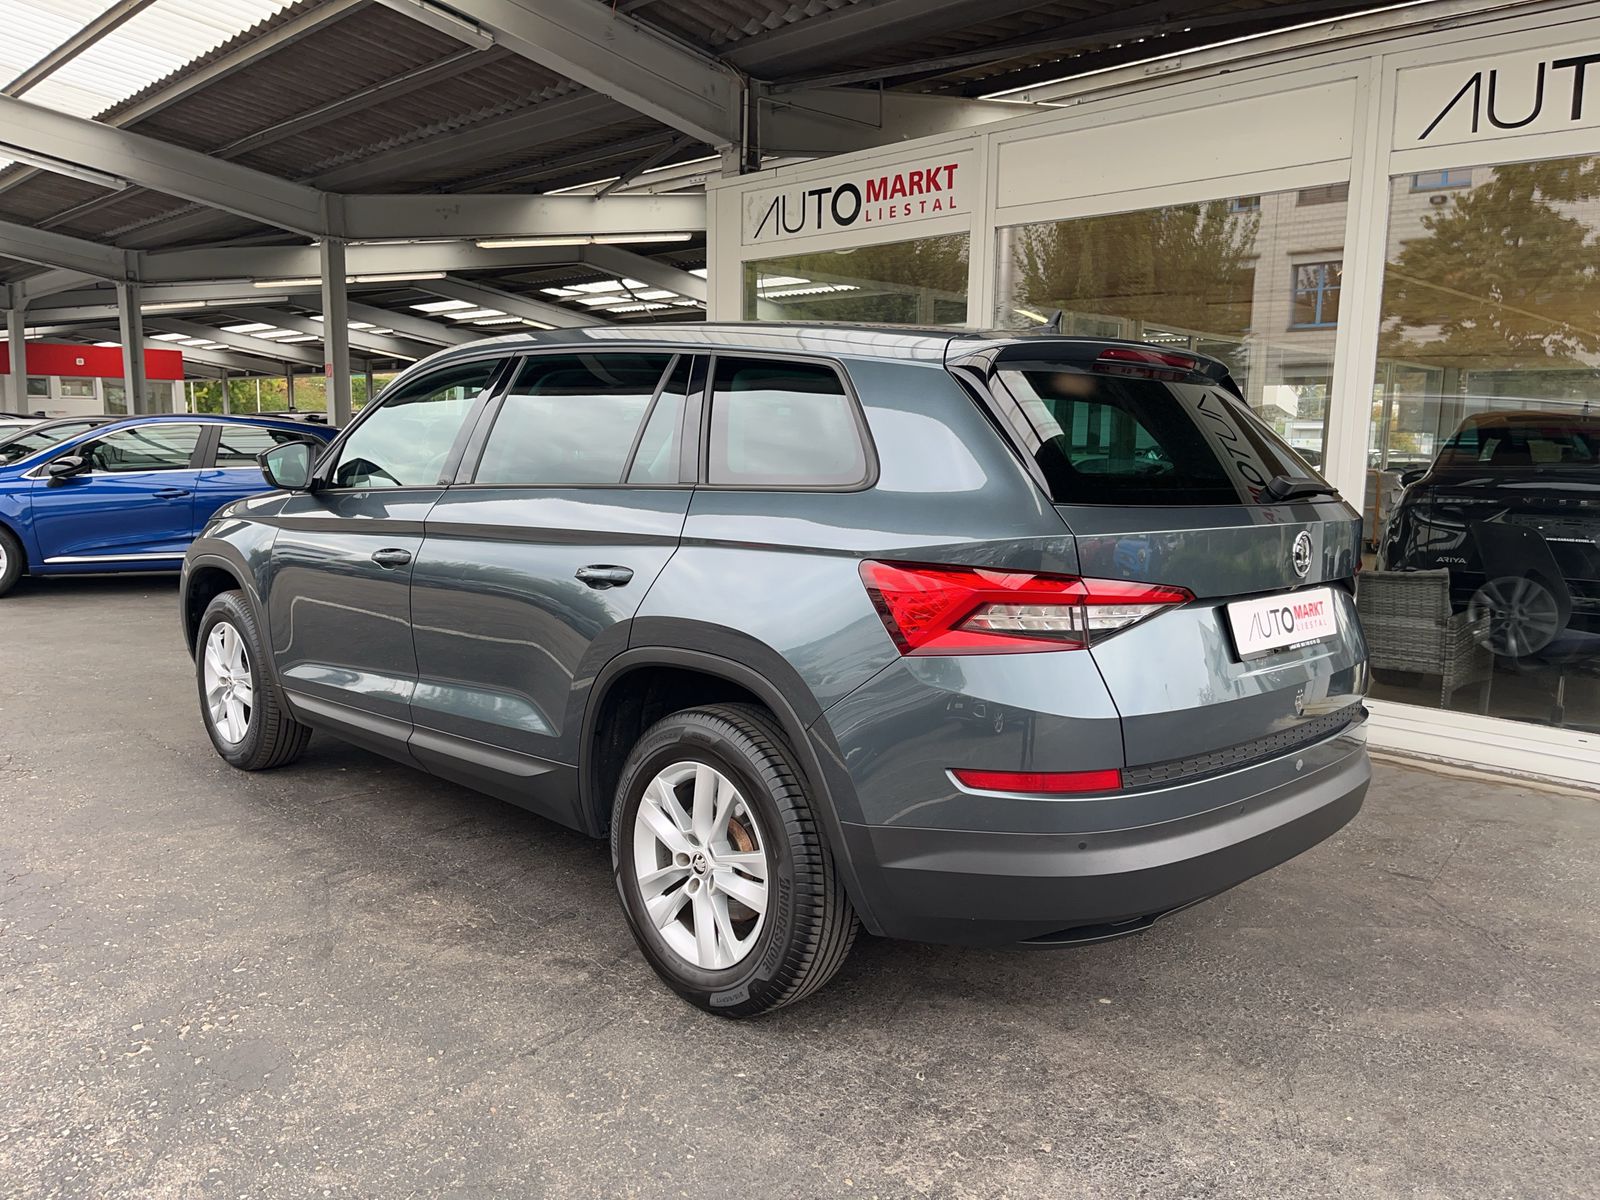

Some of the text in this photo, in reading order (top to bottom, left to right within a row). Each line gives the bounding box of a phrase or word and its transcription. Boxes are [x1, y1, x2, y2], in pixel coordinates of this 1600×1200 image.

[753, 163, 959, 239] AUTO MARKT
[865, 196, 957, 222] LIESTAL
[1435, 556, 1467, 564] ARIYA
[1249, 601, 1324, 642] AUTO MARKT
[1296, 620, 1327, 631] LIESTAL
[762, 877, 791, 975] BRIDGESTONE
